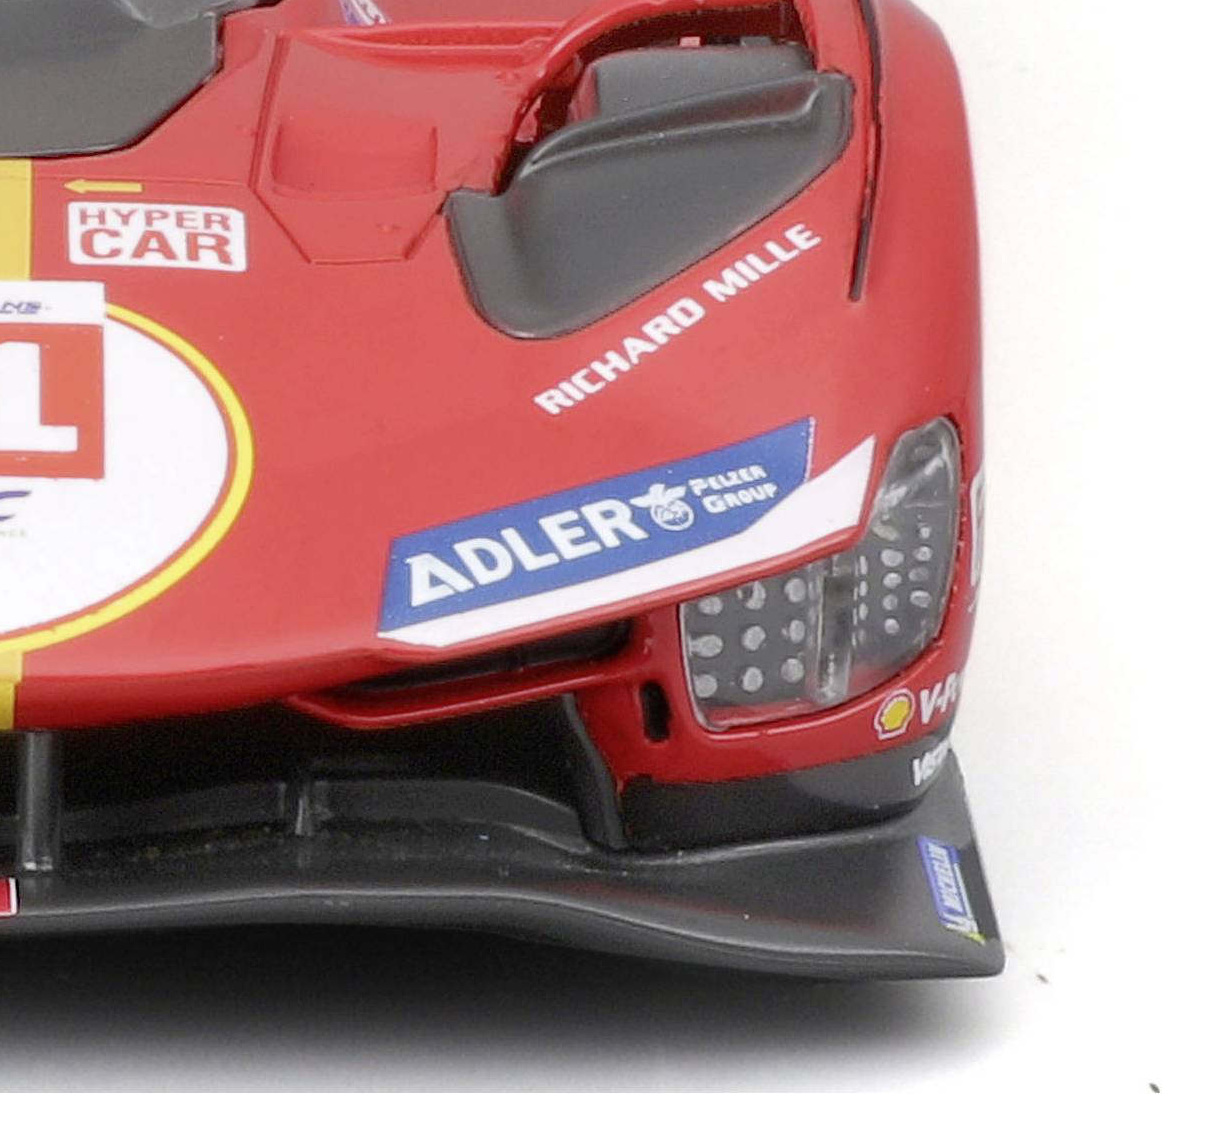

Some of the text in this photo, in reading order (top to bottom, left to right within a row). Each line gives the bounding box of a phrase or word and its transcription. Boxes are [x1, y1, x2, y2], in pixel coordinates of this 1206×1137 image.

[79, 208, 232, 231] HYPER
[80, 228, 234, 266] CAR
[533, 223, 822, 415] RICHARD MILLE
[404, 498, 650, 608] ADLER
